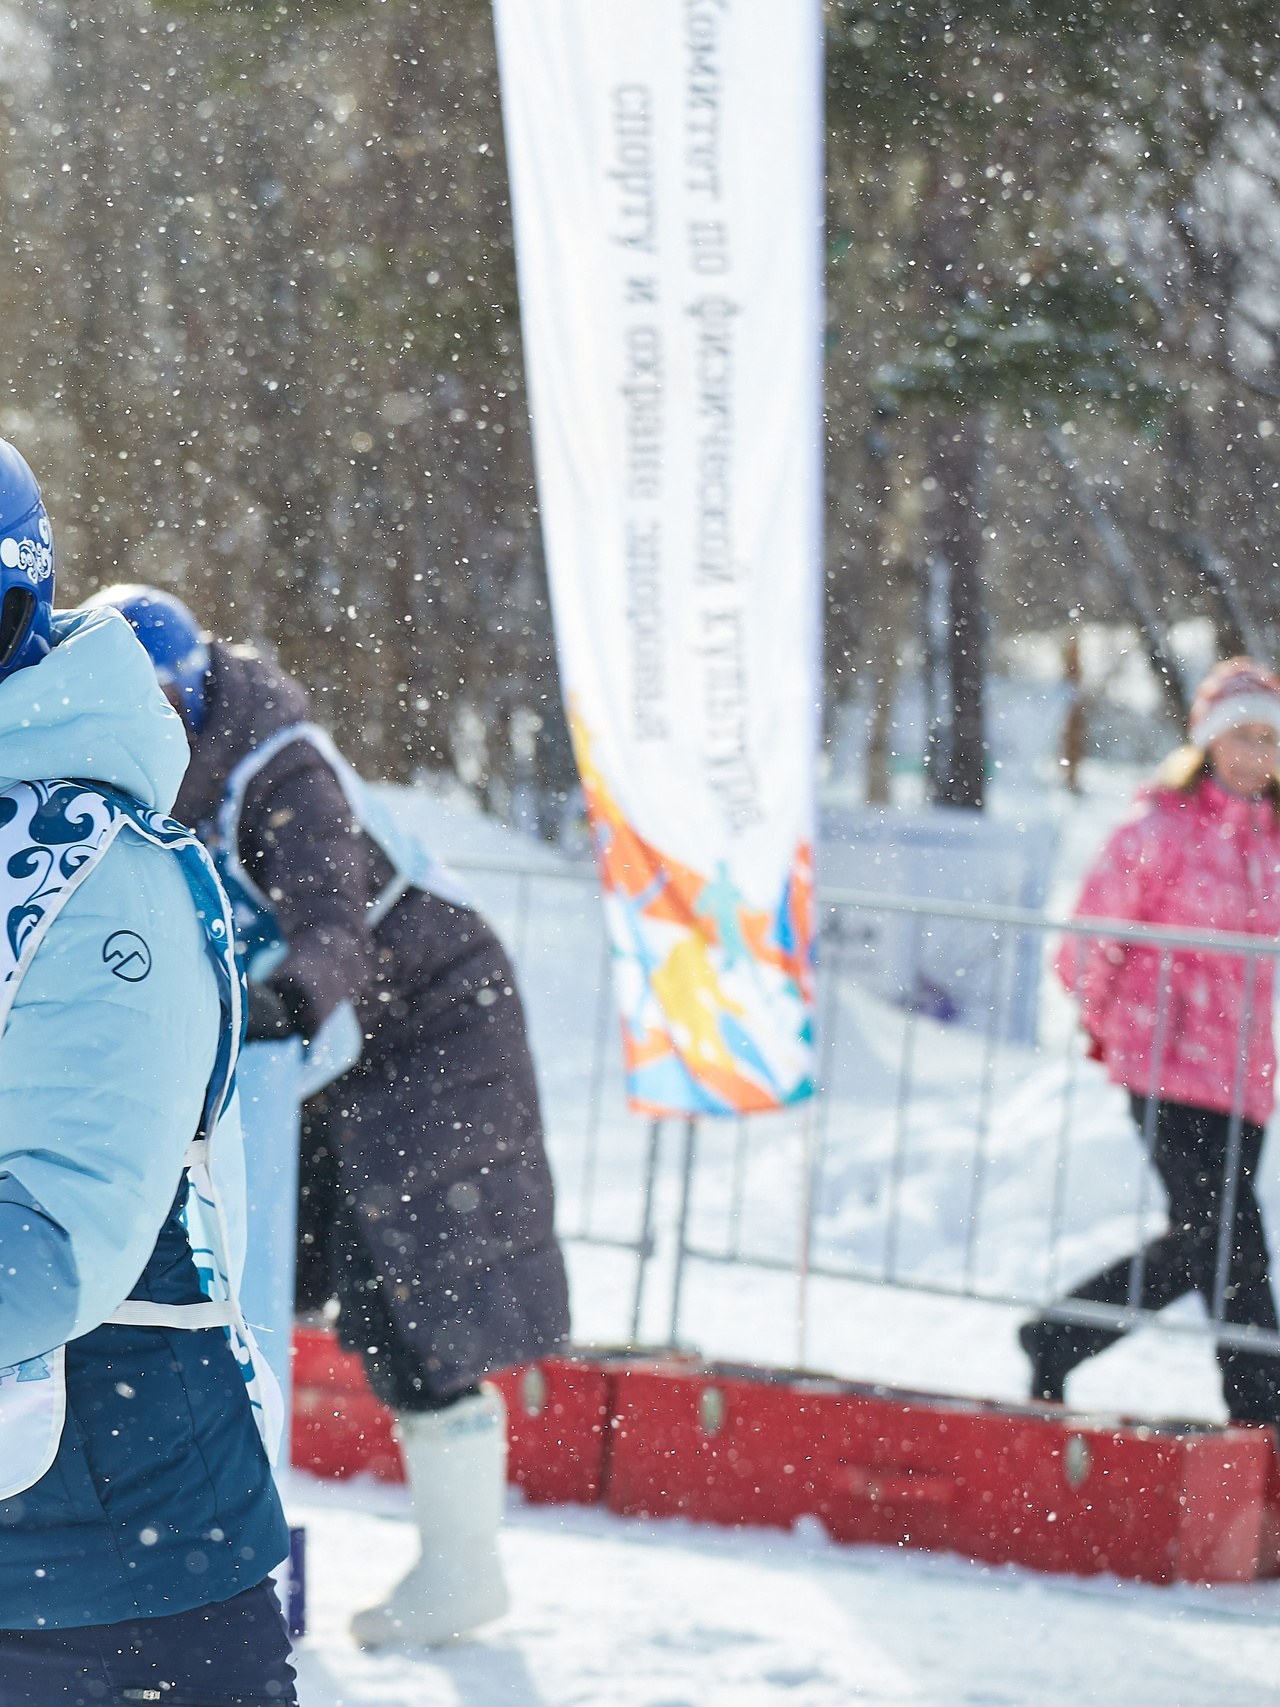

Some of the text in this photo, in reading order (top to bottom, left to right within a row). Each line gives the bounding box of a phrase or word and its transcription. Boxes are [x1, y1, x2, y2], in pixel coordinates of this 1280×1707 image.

[606, 84, 660, 256] спорту
[688, 220, 732, 276] по
[626, 276, 660, 305] и
[620, 326, 666, 500] охране
[684, 295, 750, 588] физической
